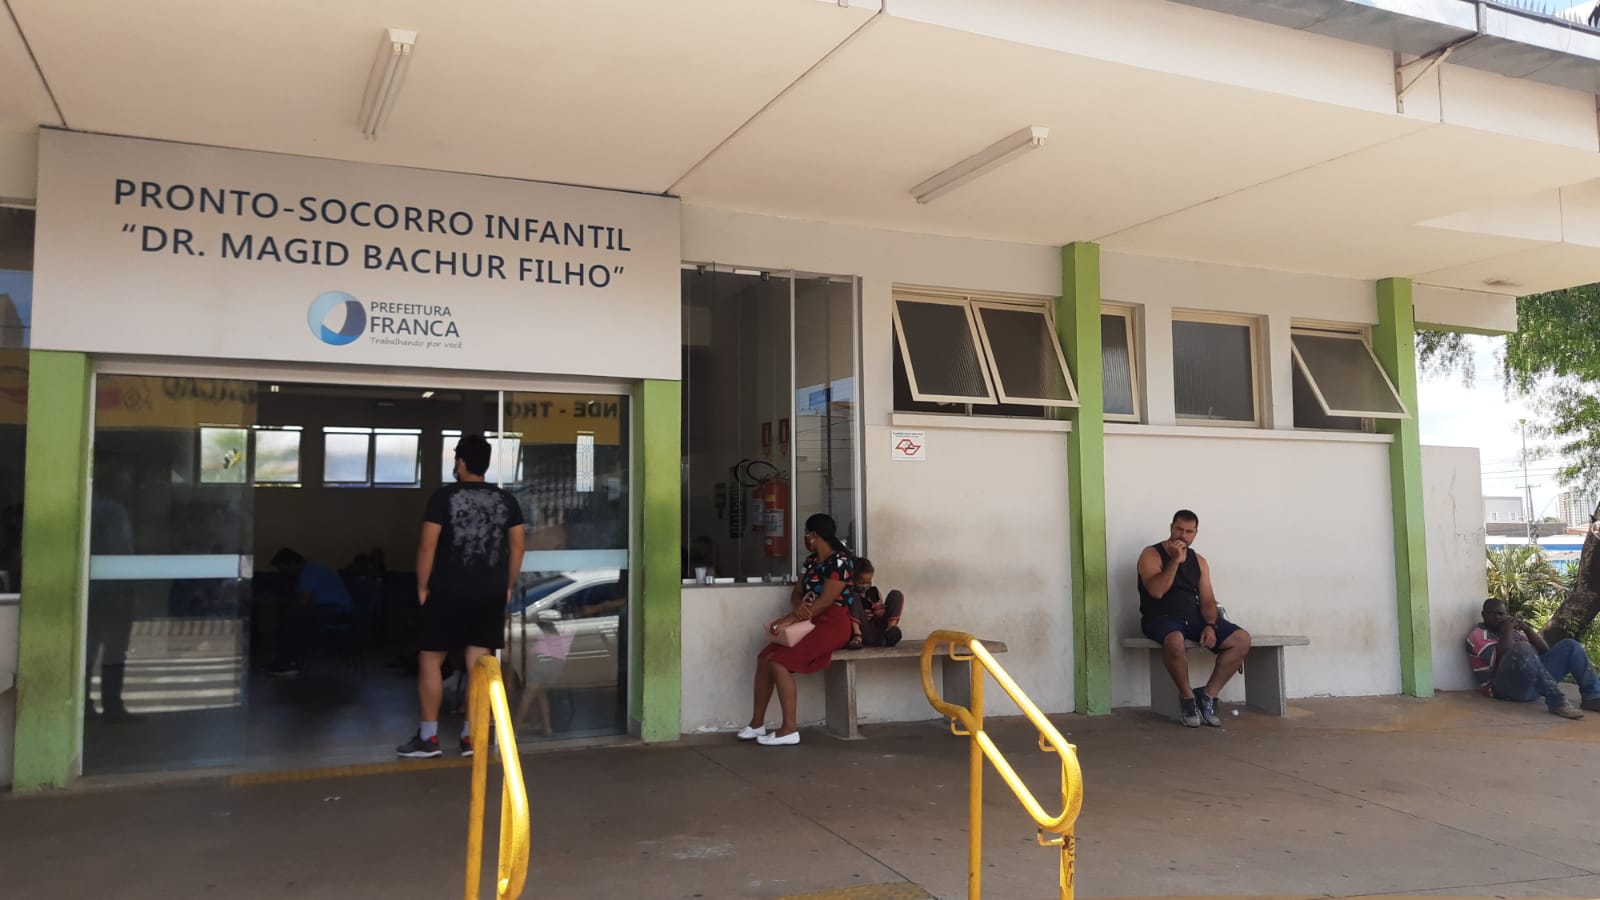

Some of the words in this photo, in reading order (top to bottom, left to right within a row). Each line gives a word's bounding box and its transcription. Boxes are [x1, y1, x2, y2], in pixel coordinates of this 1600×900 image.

[114, 178, 474, 236] PRONTO-SOCORRO
[485, 214, 631, 251] INFANTIL
[221, 232, 349, 266] MAGID
[364, 244, 506, 280] BACHUR
[370, 301, 452, 317] PREFEITURA
[370, 316, 460, 338] FRANCA
[369, 336, 424, 347] Trabalhando
[426, 340, 441, 349] por
[444, 340, 463, 349] você
